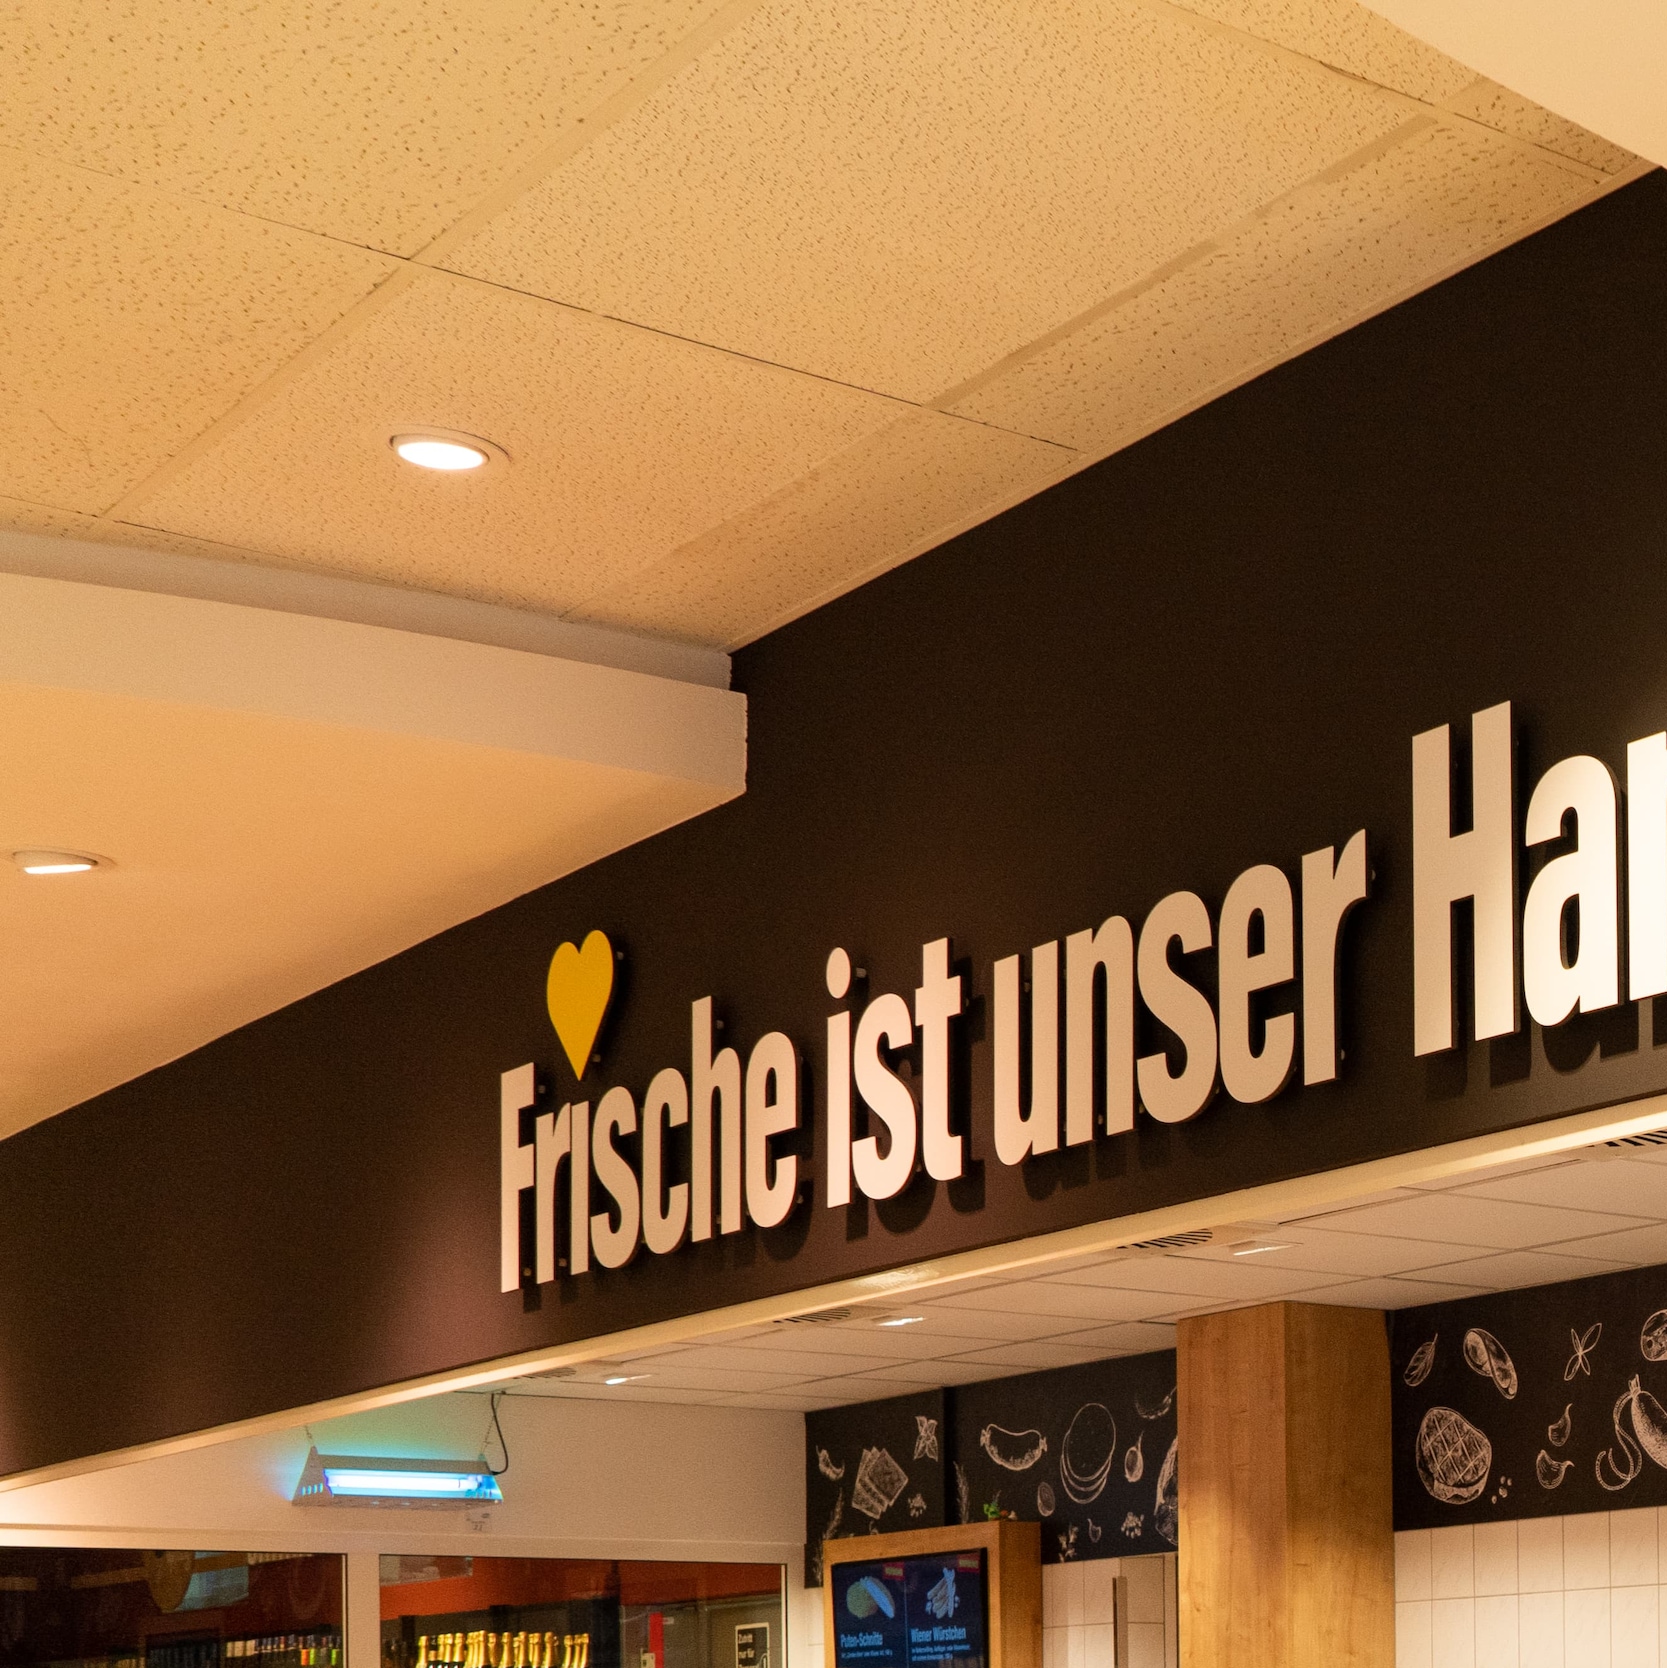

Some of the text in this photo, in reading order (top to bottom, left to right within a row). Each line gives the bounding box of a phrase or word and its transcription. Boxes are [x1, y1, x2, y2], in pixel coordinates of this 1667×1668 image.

[500, 1018, 797, 1292] Frische
[827, 947, 963, 1208] ist
[993, 828, 1368, 1138] unser
[911, 1628, 932, 1643] Wiener
